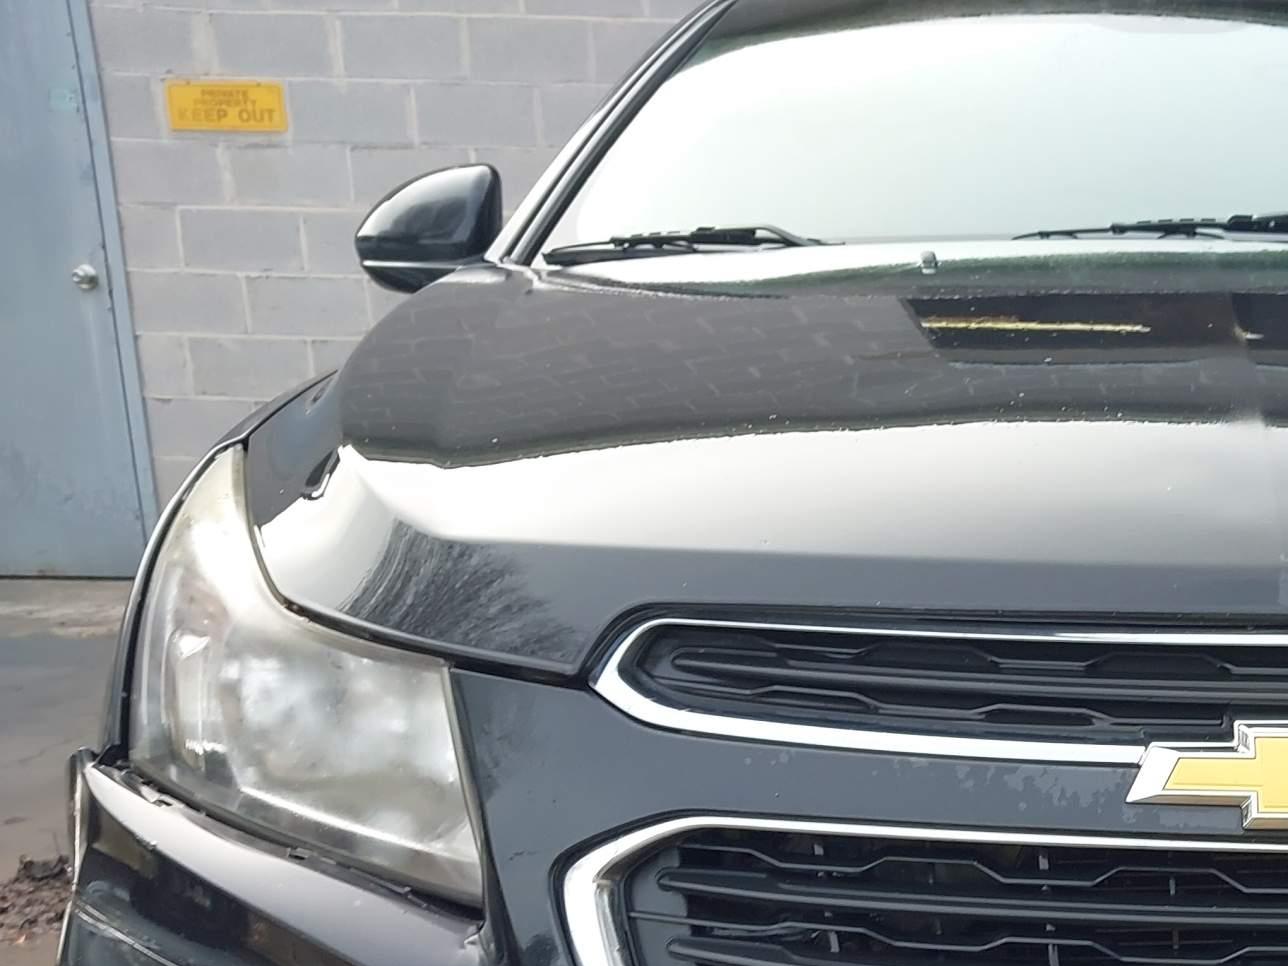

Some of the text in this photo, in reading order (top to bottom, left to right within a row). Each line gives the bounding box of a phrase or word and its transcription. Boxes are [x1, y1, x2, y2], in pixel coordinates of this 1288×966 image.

[201, 88, 248, 98] PRIVATE
[193, 98, 257, 108] PROPERTY
[177, 107, 276, 123] KEEP OUT
